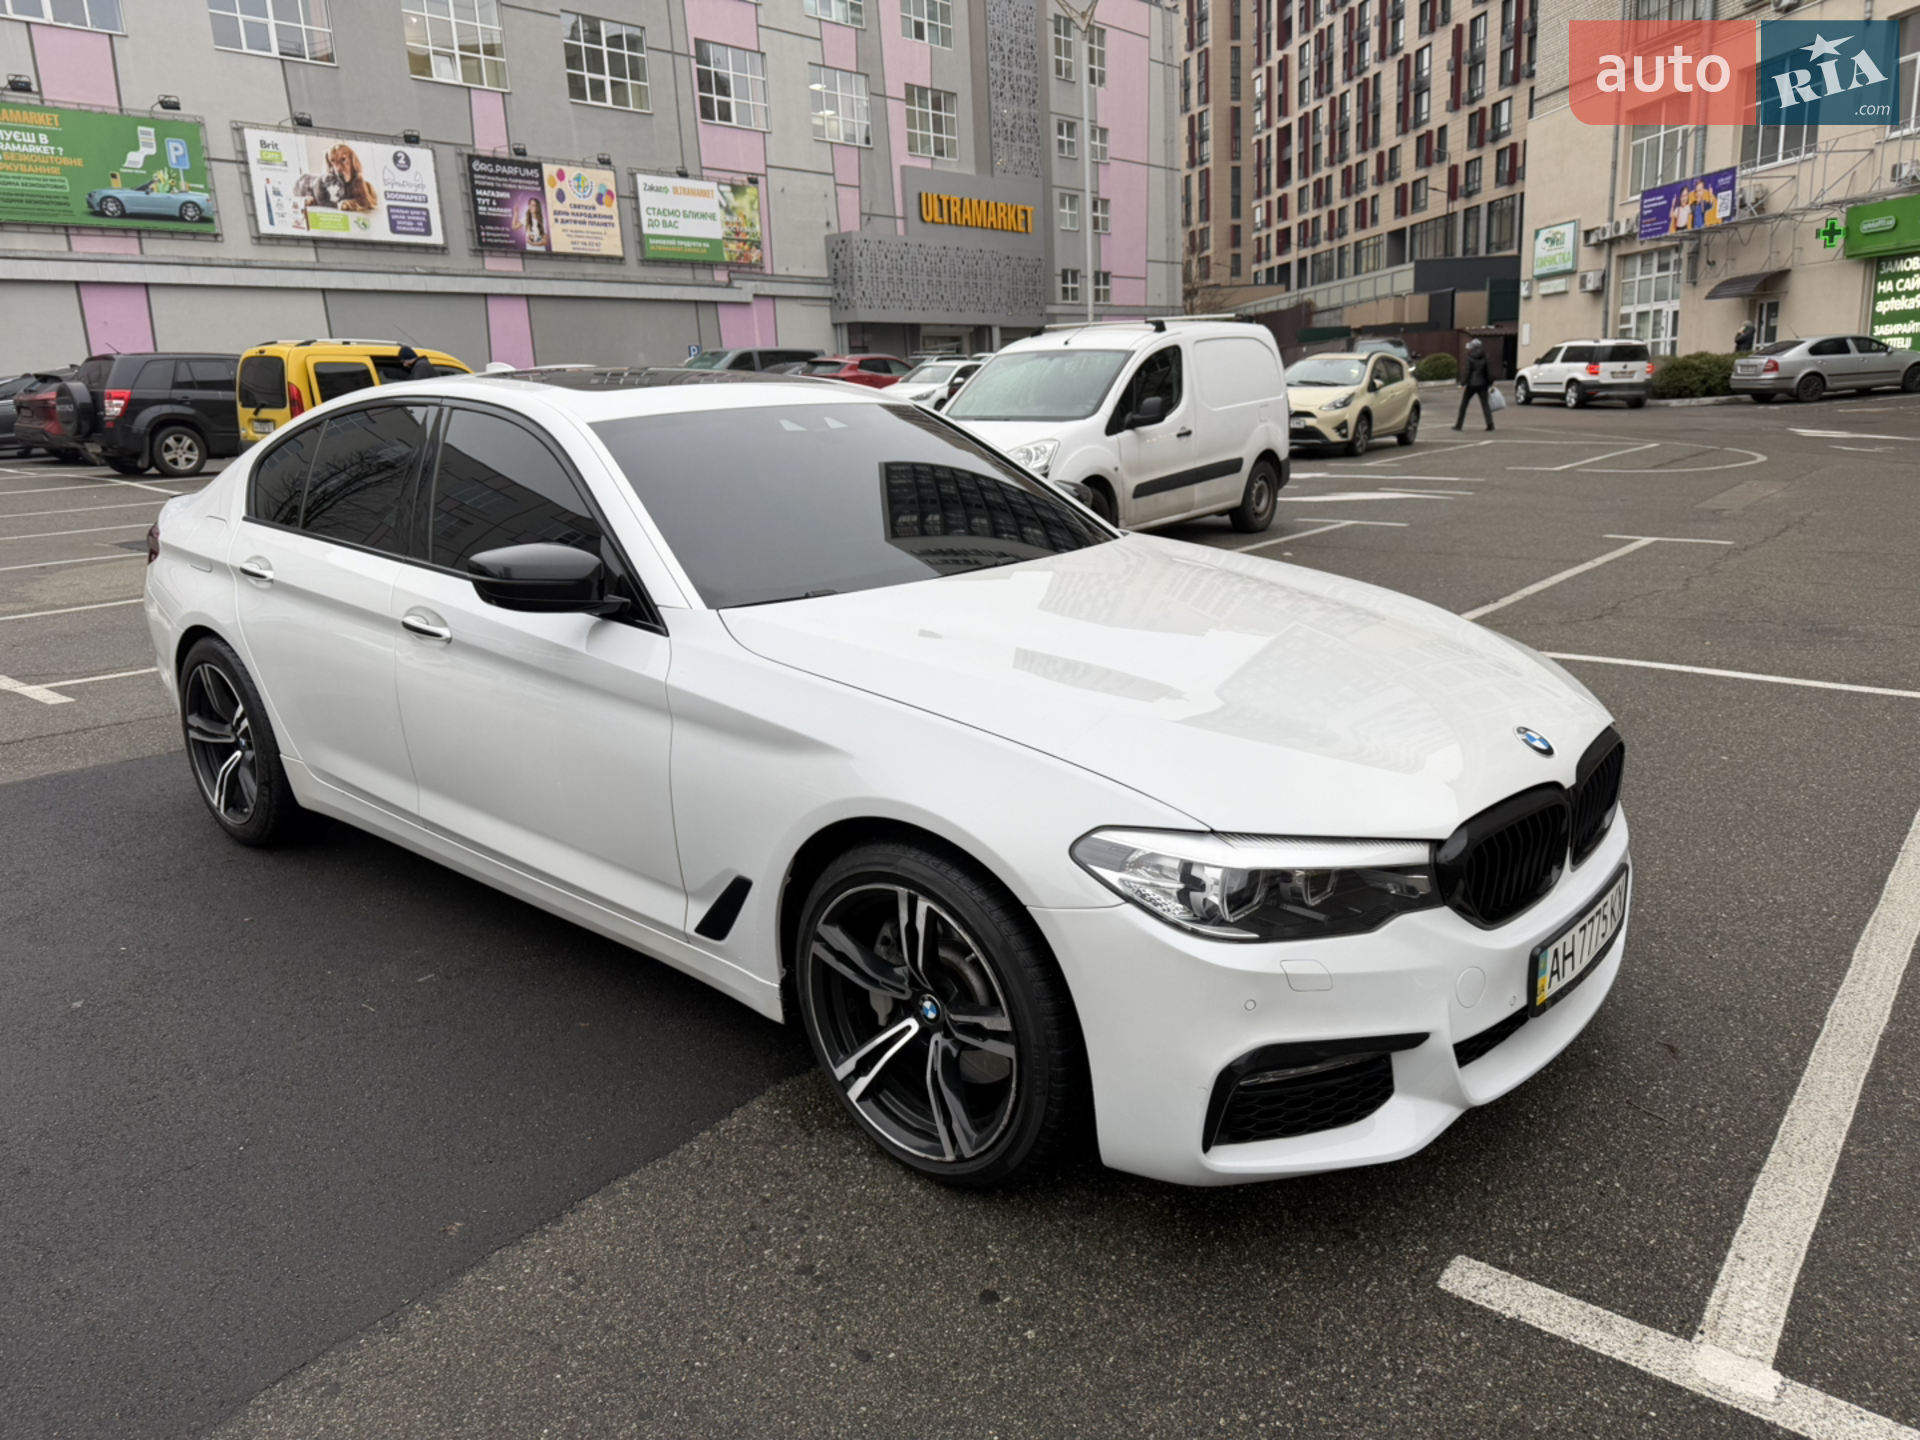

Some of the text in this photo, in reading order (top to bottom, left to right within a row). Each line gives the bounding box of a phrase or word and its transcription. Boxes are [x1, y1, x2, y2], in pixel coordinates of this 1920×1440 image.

[0, 108, 60, 128] AMARKET
[260, 139, 280, 150] Brit
[3, 152, 84, 167] БЕЗКОШТОВНЕ
[396, 152, 407, 165] 2
[386, 192, 427, 203] ЗООМАРКЕТ
[475, 189, 511, 199] МАГАЗИН
[672, 186, 715, 199] ULTRAMARKET
[477, 197, 491, 206] ТУТ
[569, 203, 597, 211] СВЯТКУЙ
[553, 209, 614, 220] ДЕНЬ НАРОДЖЕННЯ
[646, 206, 718, 222] СТАЄМО БЛИЖЧЕ
[919, 191, 1035, 233] ULTRAMARKET
[560, 218, 587, 226] ДИТЯЧІЙ
[647, 218, 679, 230] ДО ВАС
[1877, 279, 1894, 295] НА
